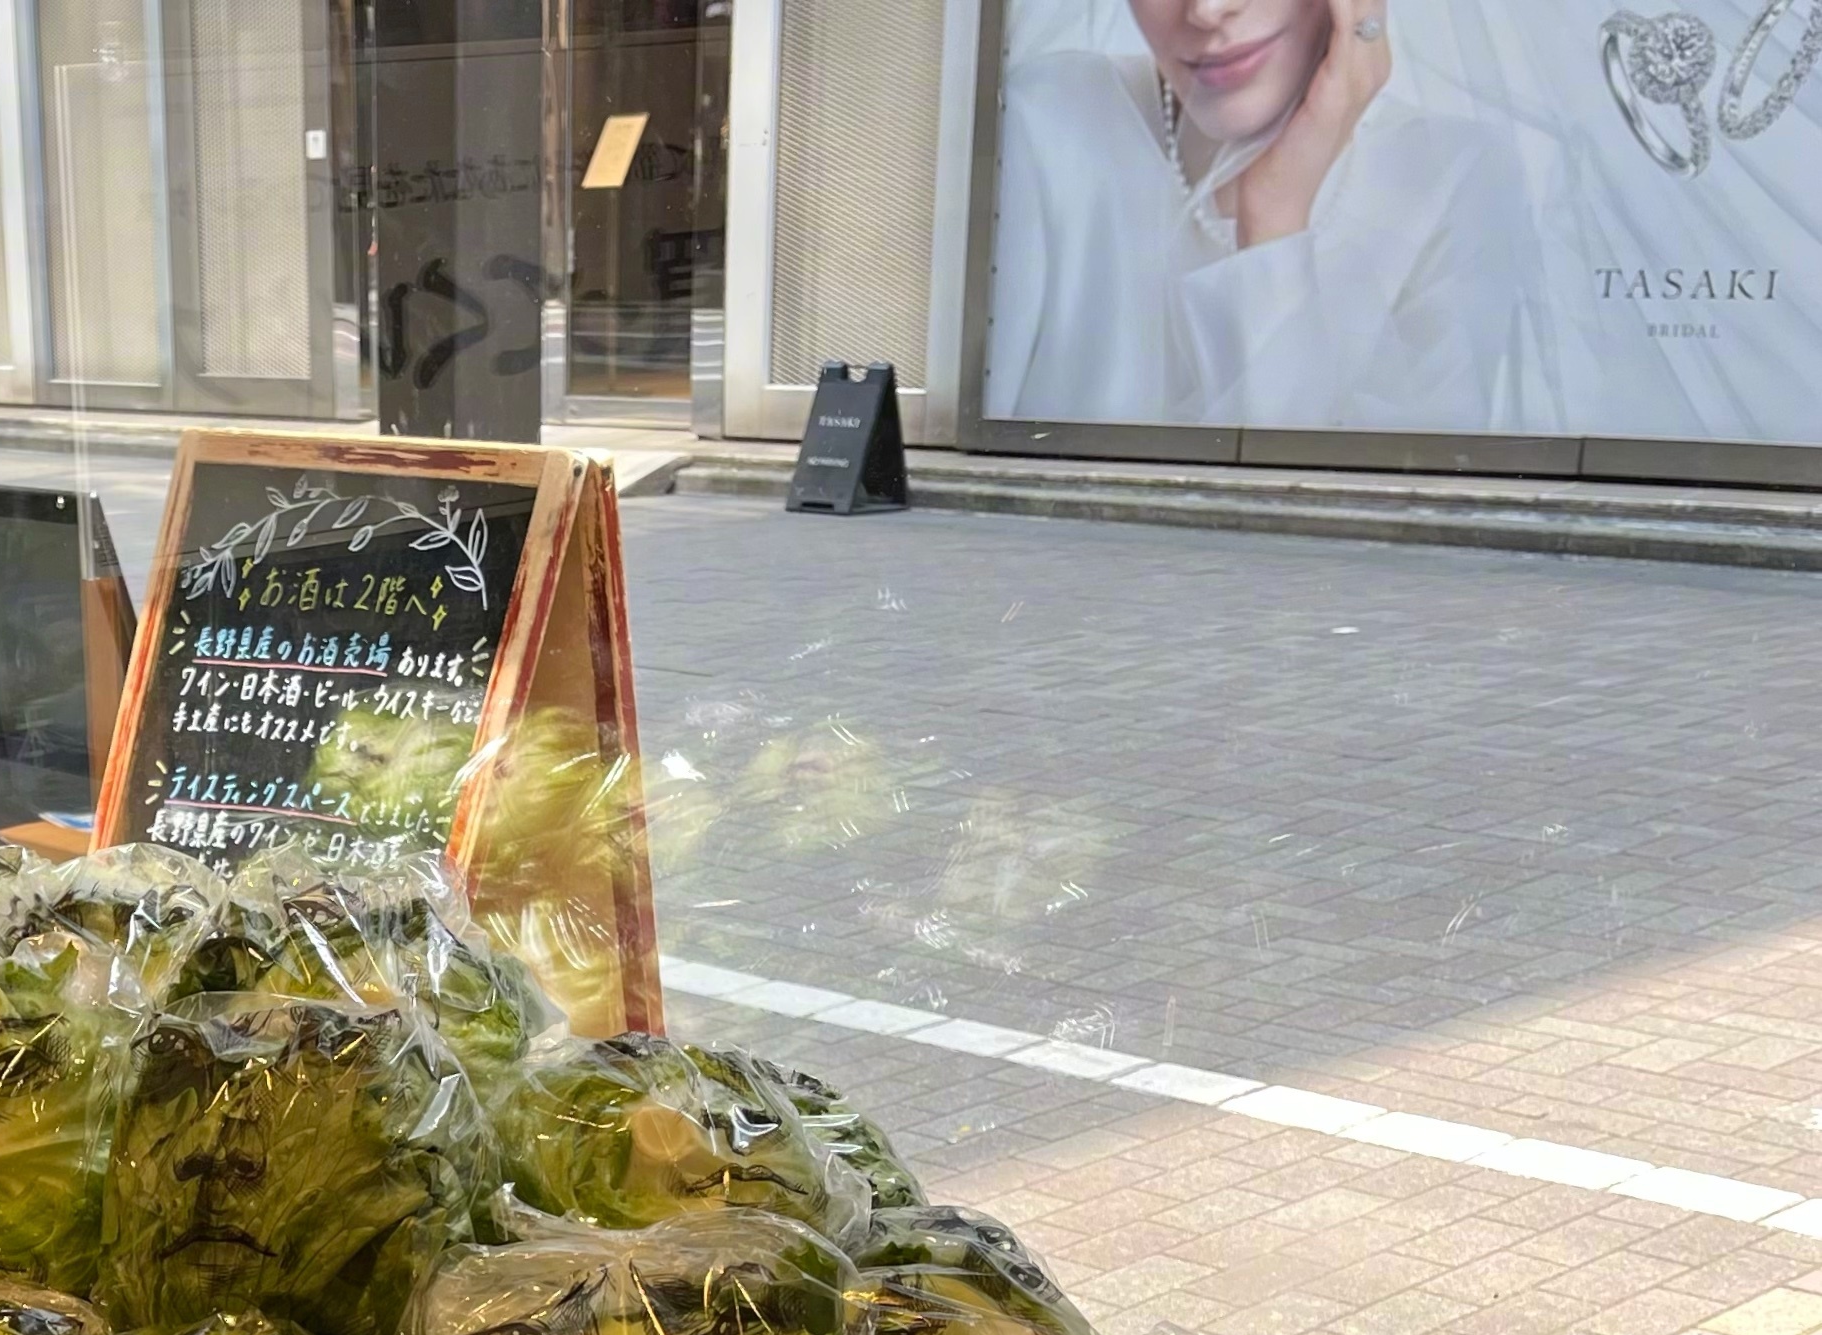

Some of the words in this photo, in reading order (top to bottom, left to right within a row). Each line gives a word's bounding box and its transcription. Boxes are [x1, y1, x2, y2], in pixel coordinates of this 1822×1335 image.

[1594, 268, 1780, 300] TASAKI
[1647, 323, 1721, 338] BRIDAL
[260, 567, 427, 616] お酒は2階へ
